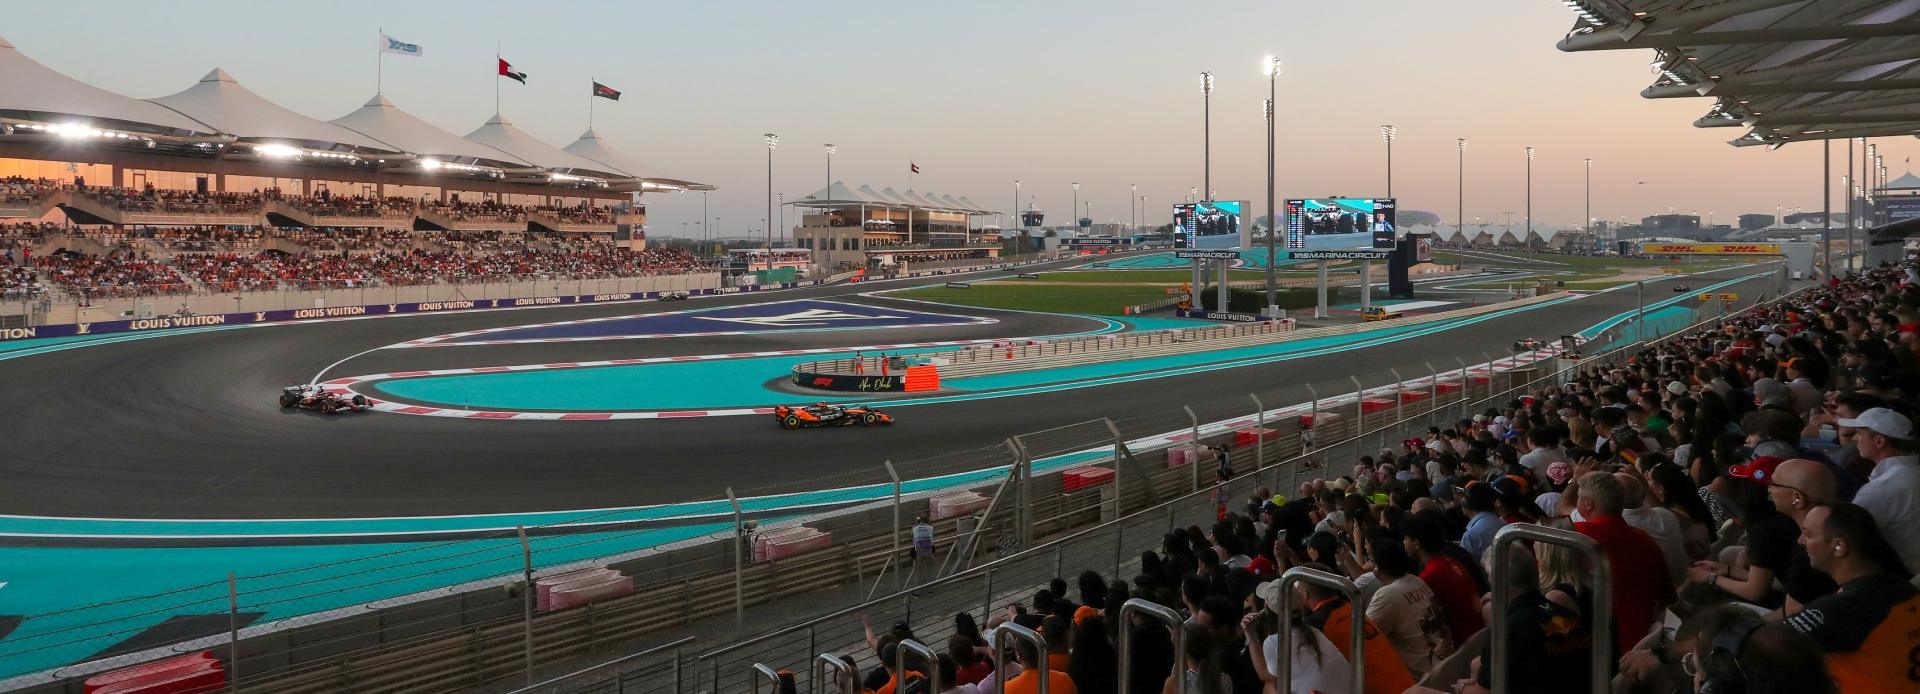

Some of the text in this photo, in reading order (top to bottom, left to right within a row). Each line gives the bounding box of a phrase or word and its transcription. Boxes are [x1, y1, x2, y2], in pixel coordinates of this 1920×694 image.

[515, 296, 560, 306] LOUIS VUITTON
[594, 293, 631, 302] LOUIS VUITTON
[419, 301, 474, 311] LOUIS VUITTON
[294, 306, 366, 319] LOUIS VUITTON
[1207, 312, 1256, 322] LOUIS VUITTON
[131, 315, 225, 330] LOUIS VUITTON
